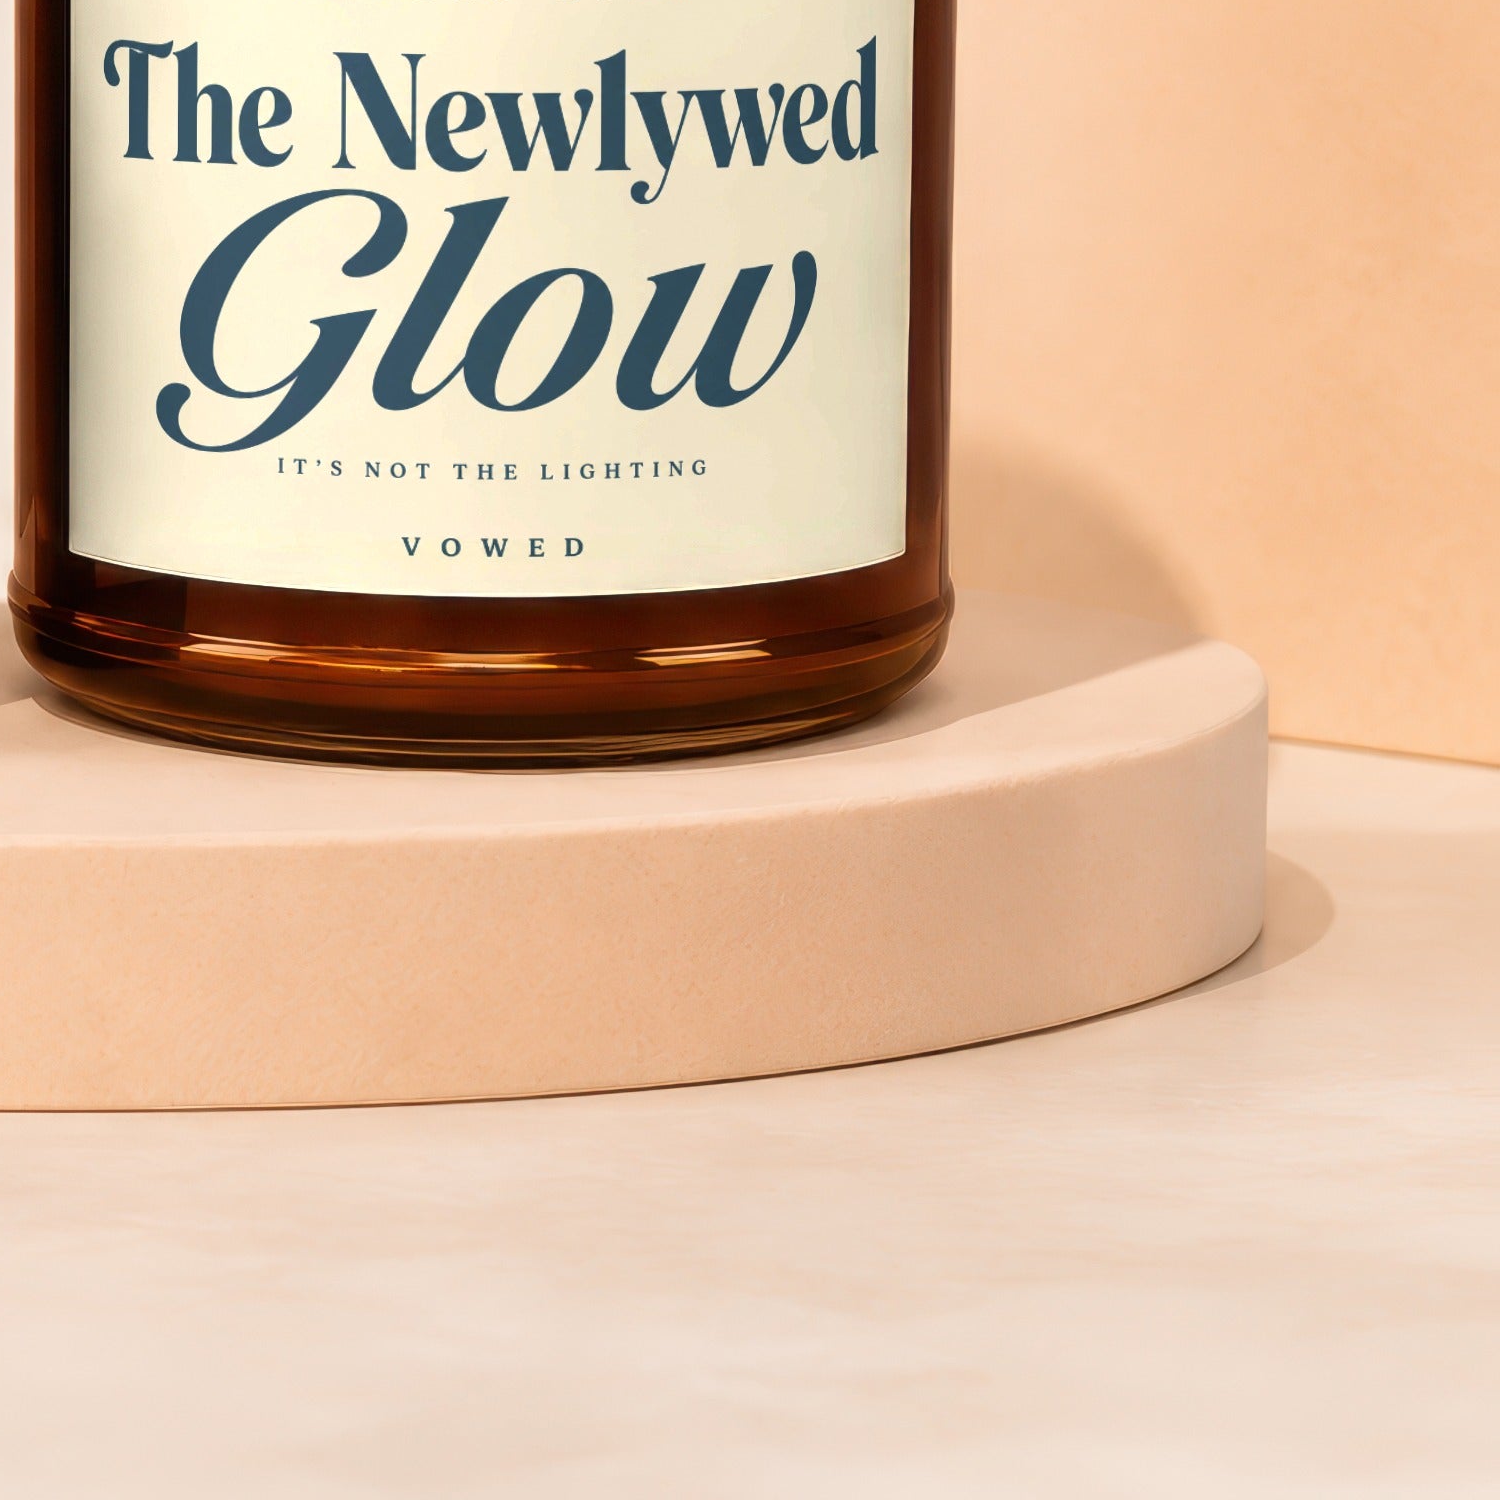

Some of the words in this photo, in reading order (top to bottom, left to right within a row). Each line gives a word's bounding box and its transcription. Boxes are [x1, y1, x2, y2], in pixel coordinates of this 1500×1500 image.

[102, 38, 294, 168] The
[332, 34, 879, 205] Newlywed
[155, 188, 818, 453] Glow
[276, 457, 345, 478] IT'S
[364, 460, 430, 481] NOT
[452, 462, 519, 481] THE
[539, 458, 709, 481] LIGHTING
[401, 535, 587, 559] VOWED
